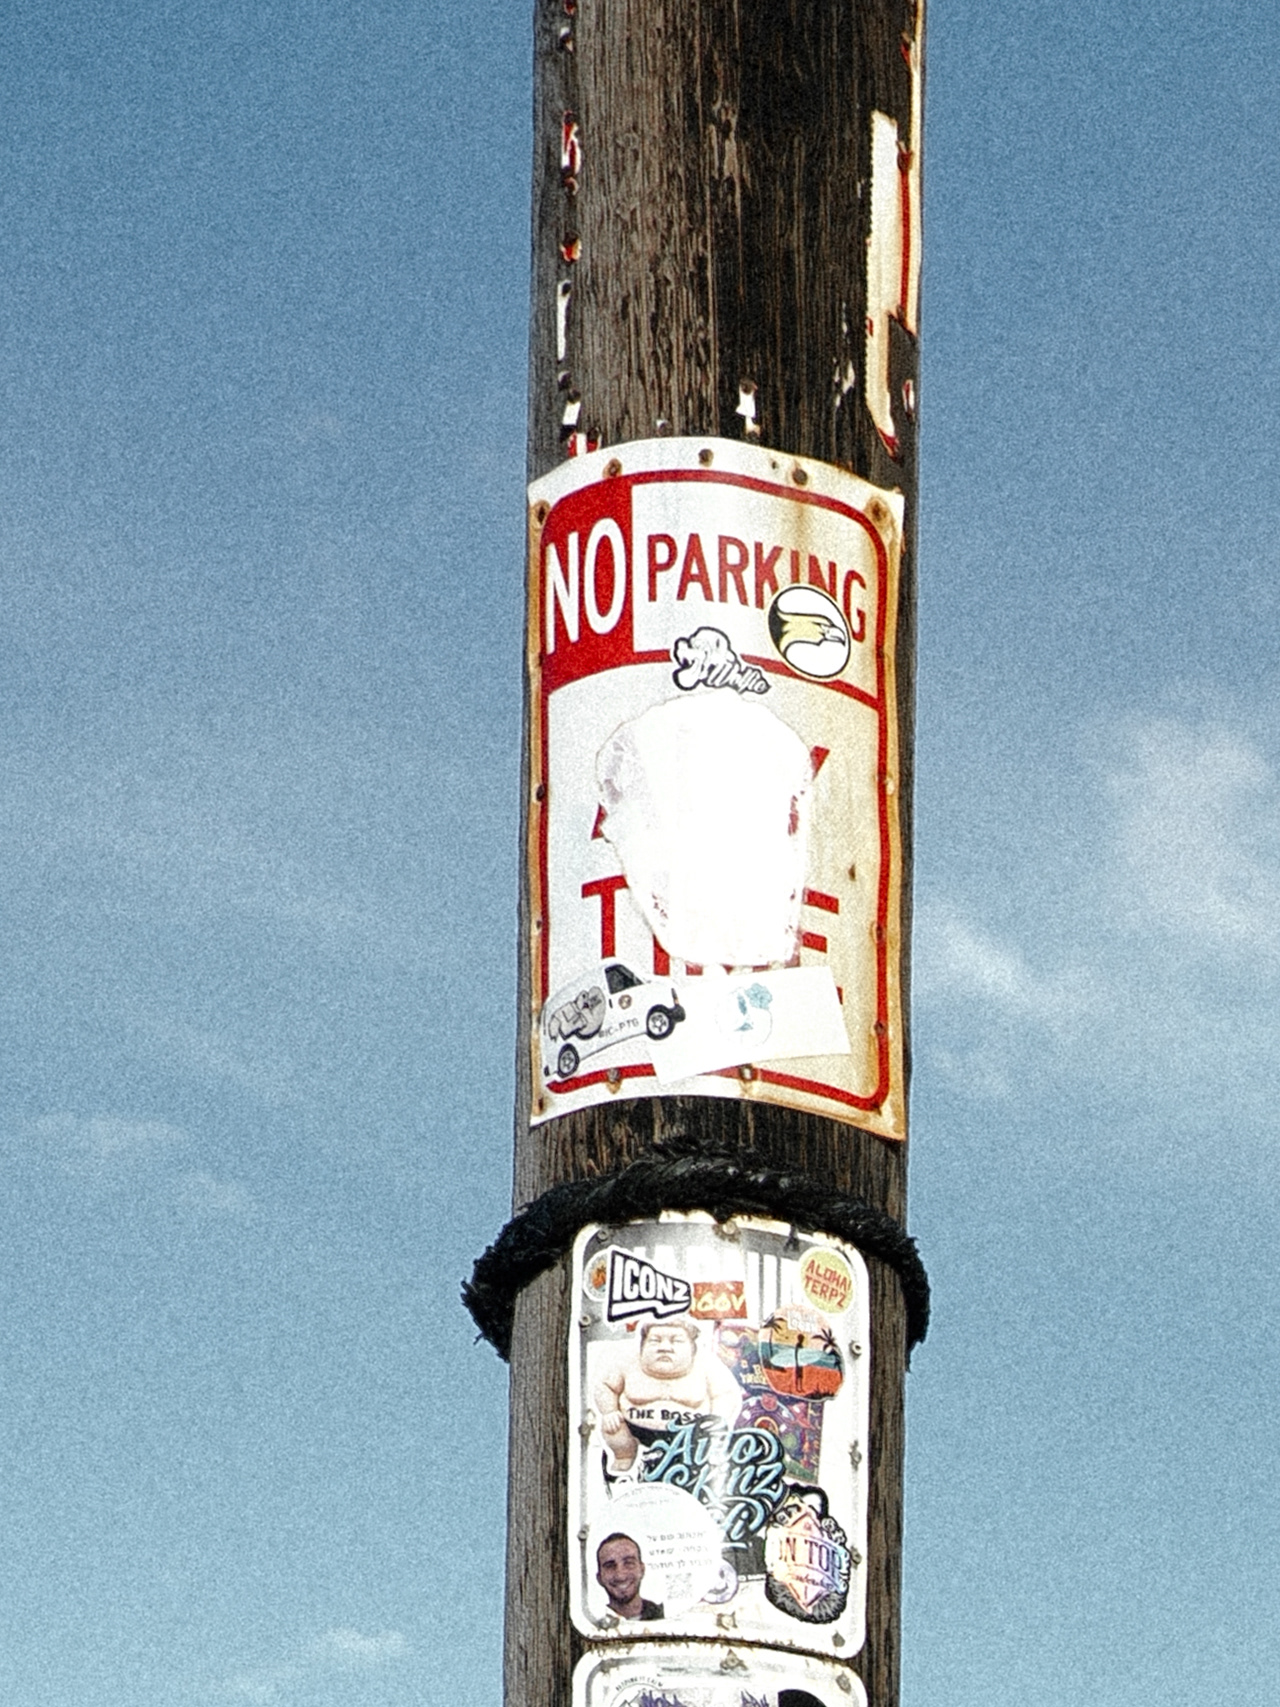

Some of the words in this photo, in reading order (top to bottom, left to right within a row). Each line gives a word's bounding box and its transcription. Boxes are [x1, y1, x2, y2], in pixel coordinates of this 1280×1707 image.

[545, 517, 627, 655] NO
[646, 532, 868, 643] PARKING
[612, 1255, 691, 1302] ICONZ
[626, 1406, 655, 1419] THE
